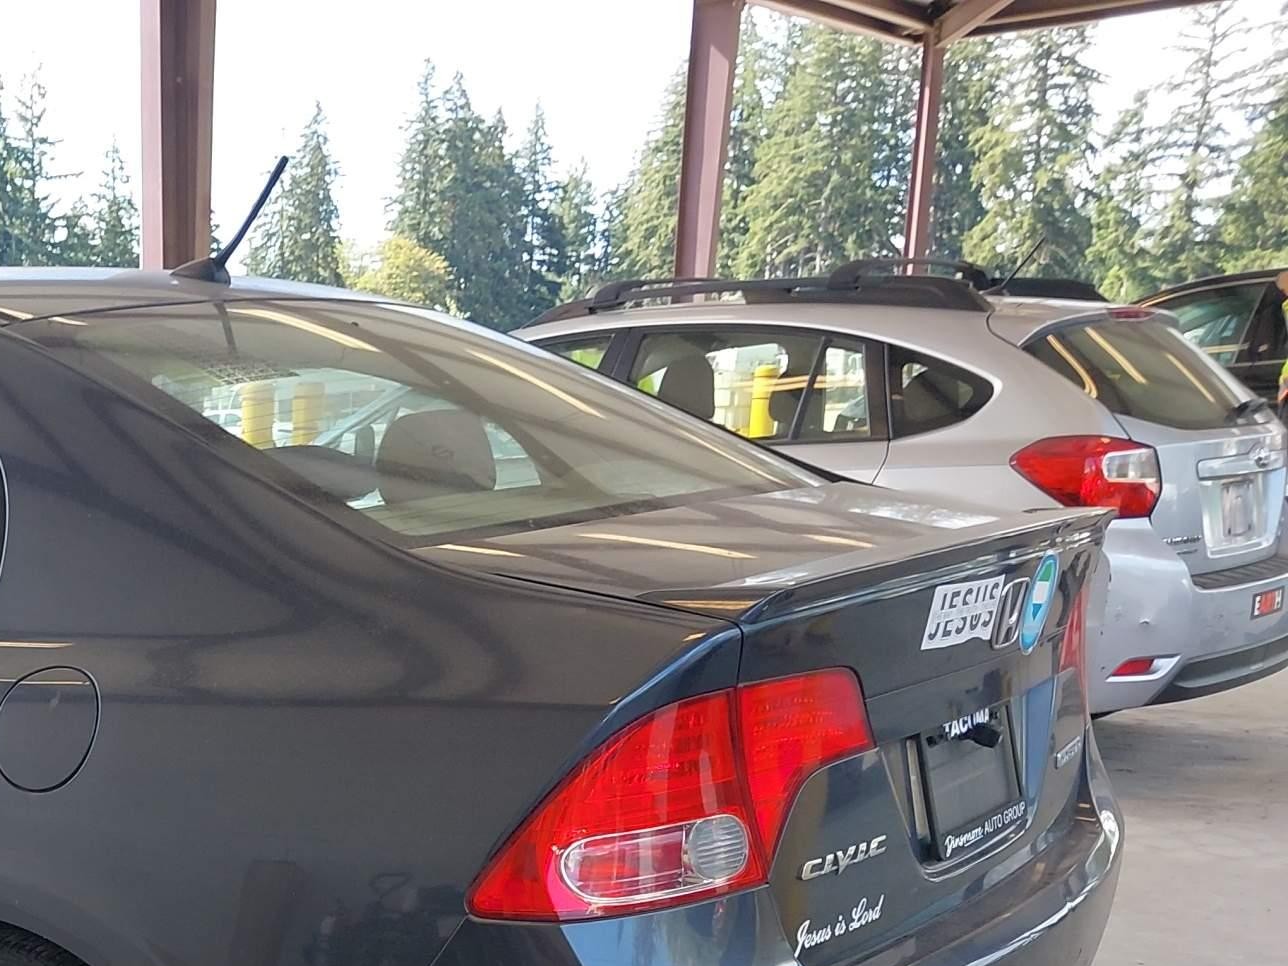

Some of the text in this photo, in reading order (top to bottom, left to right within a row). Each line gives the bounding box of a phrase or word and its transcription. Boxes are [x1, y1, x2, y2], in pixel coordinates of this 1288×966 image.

[984, 813, 1003, 835] AUTO
[1003, 801, 1026, 824] GROUP
[801, 834, 887, 881] CIVIC
[794, 893, 885, 959] Jesus is Lord
